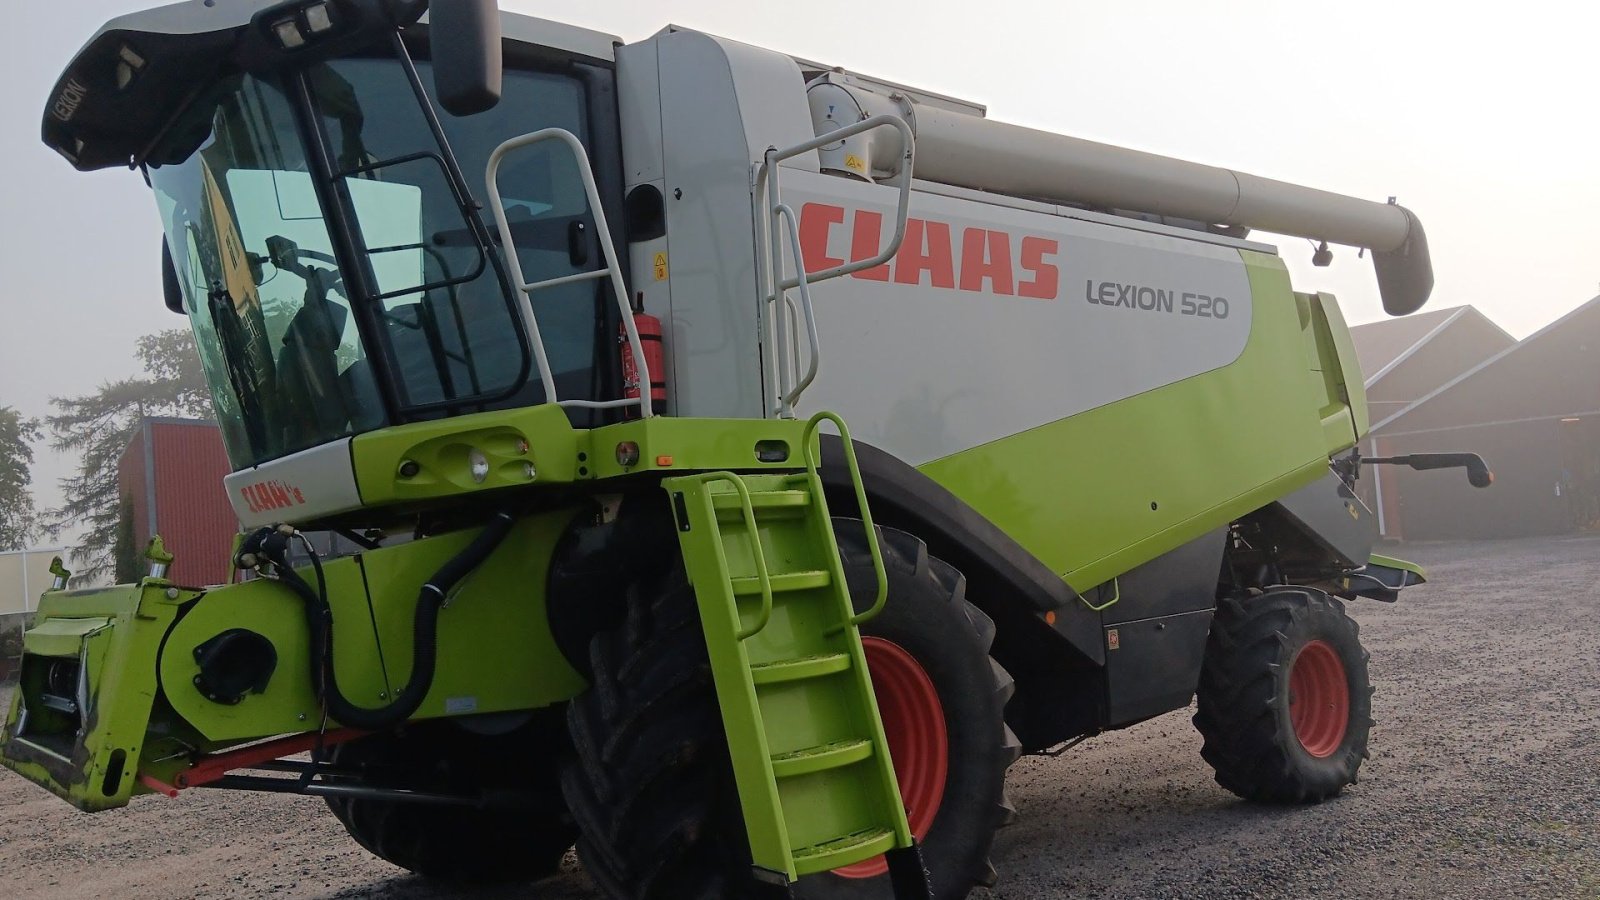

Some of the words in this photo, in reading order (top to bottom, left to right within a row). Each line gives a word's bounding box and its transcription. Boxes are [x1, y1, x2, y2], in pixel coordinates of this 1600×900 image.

[52, 79, 87, 121] LEXION
[799, 202, 1059, 299] CLAAS
[1086, 279, 1174, 313] LEXION
[1181, 292, 1229, 319] 520
